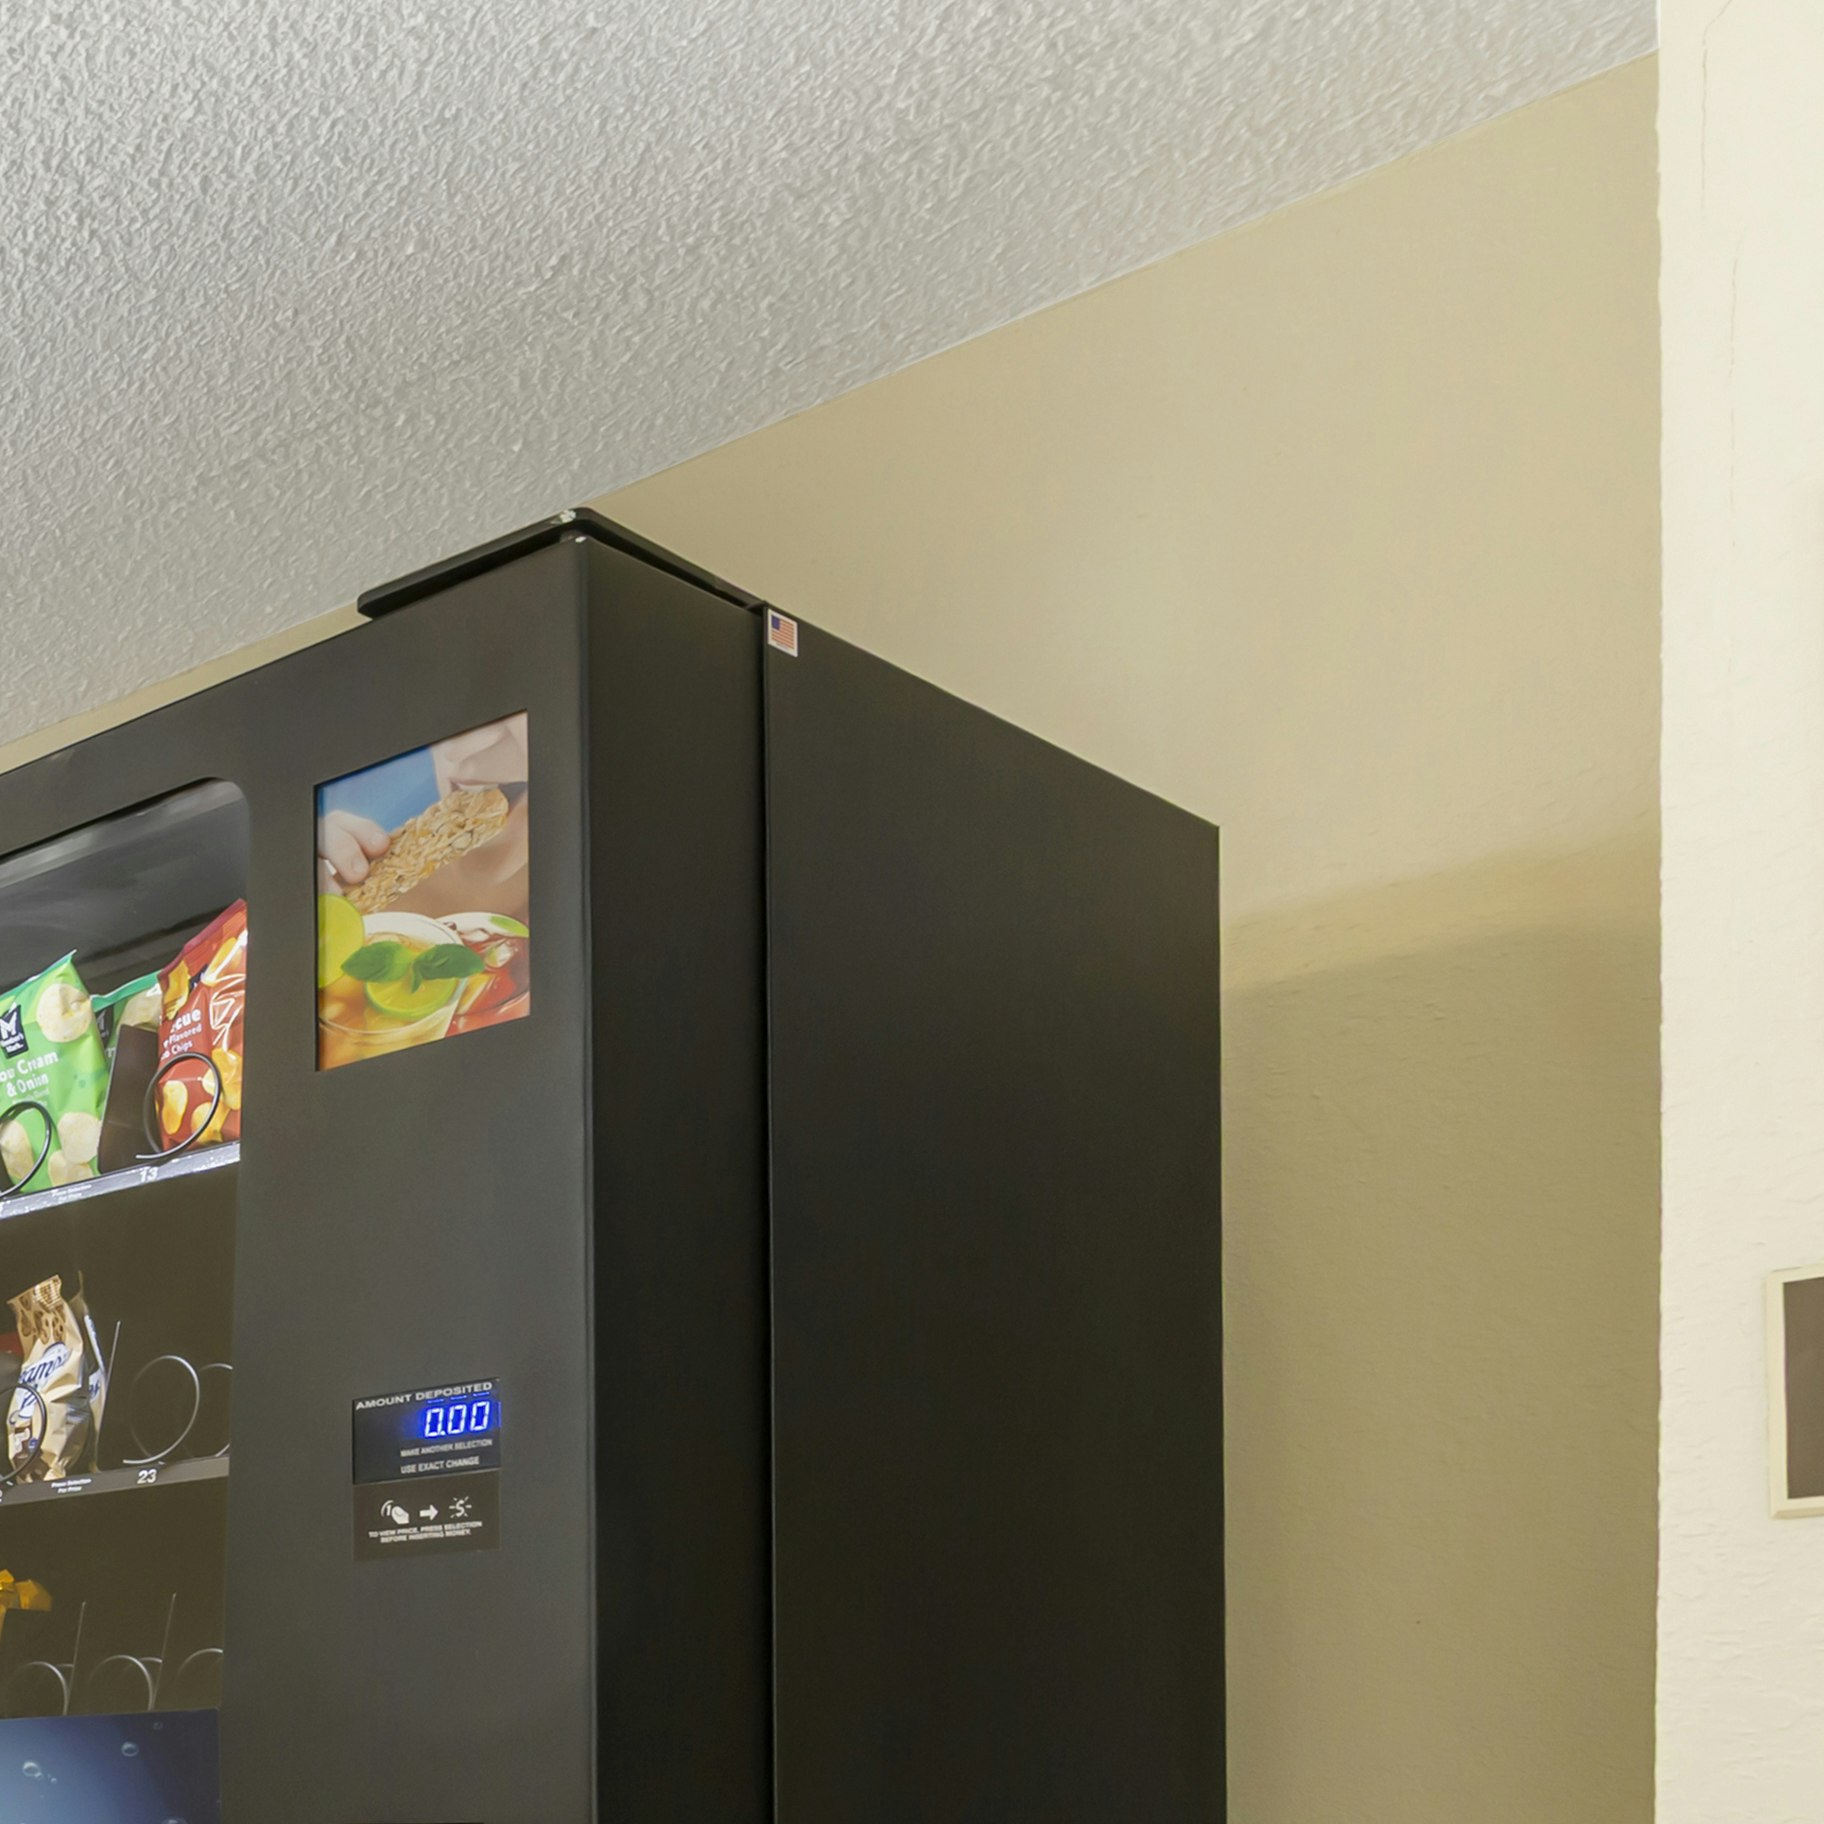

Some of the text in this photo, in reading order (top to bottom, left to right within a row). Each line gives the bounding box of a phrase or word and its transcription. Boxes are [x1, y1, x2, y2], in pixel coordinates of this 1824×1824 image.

[139, 1167, 158, 1183] 13
[355, 1382, 493, 1411] AMOUNT DEPOSITED
[424, 1401, 490, 1437] 0.00
[400, 1439, 493, 1458] MAKE ANOTHER SELECTION
[400, 1456, 480, 1474] USE EXACT CHANGE
[137, 1469, 157, 1485] 23
[444, 1521, 482, 1530] SELECTION
